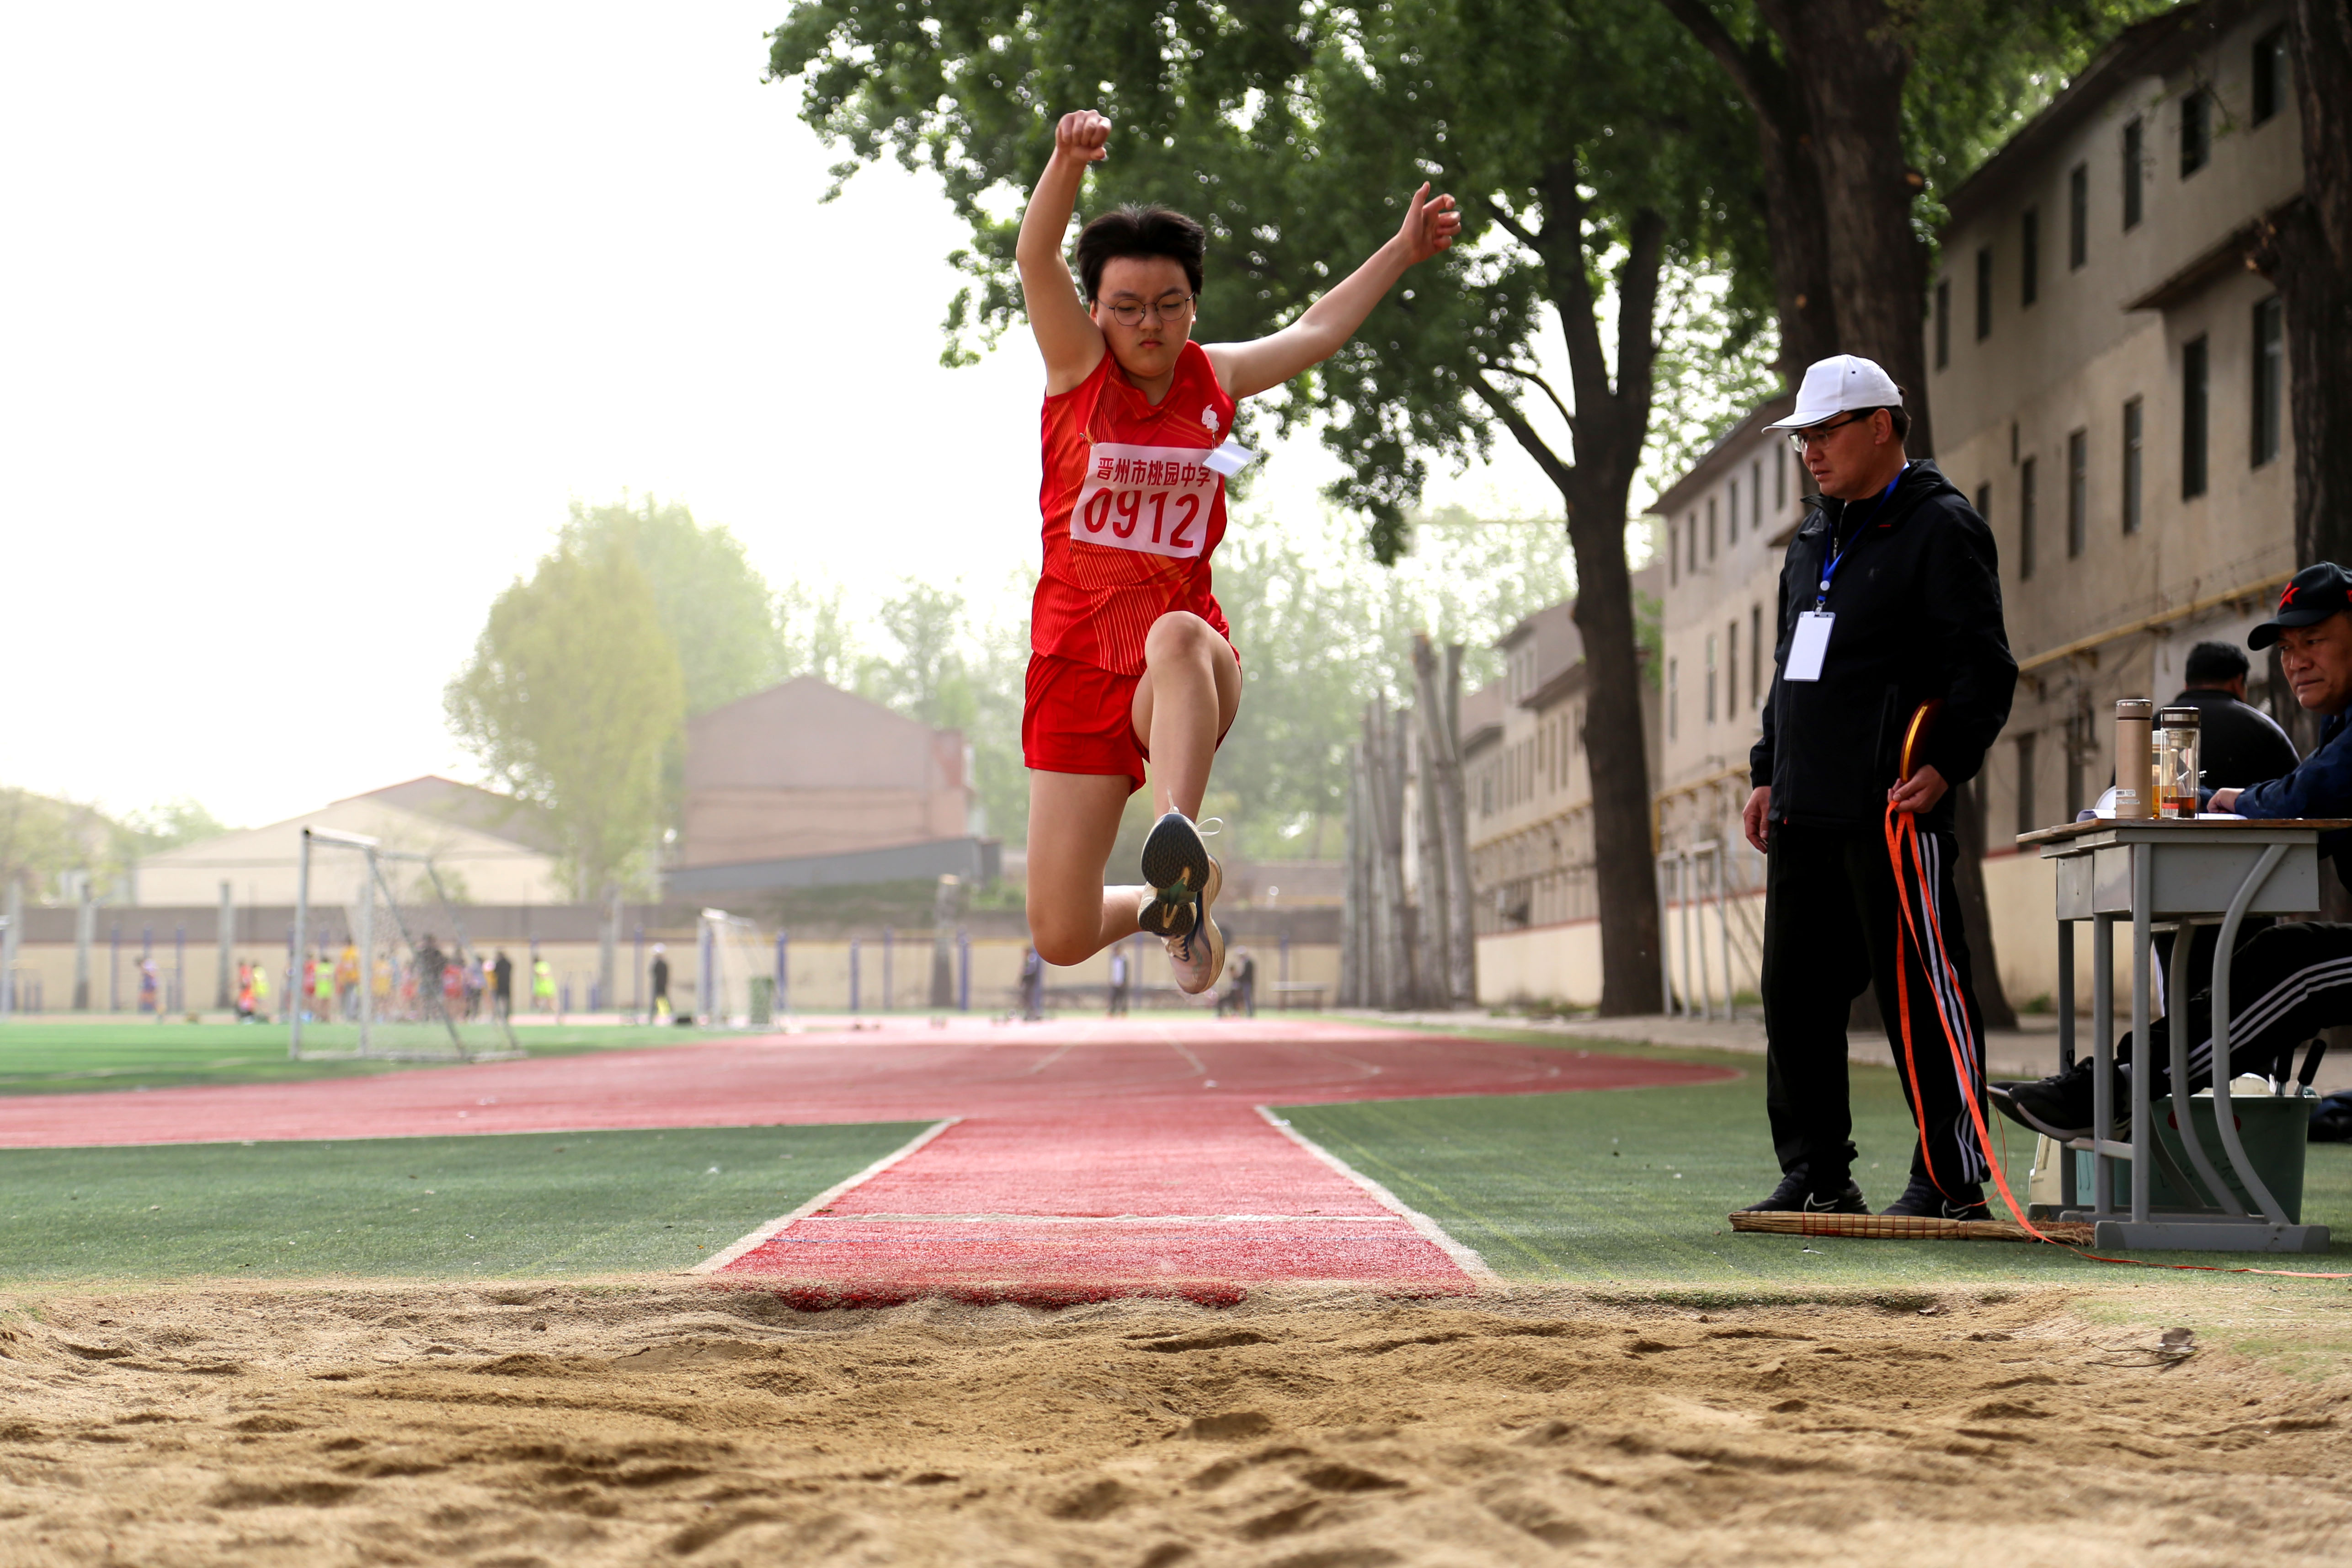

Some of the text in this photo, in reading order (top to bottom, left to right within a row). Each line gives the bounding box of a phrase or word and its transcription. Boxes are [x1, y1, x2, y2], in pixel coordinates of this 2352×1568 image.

[1097, 457, 1211, 487] 晋州市桃园中学
[1084, 487, 1200, 549] 0912
